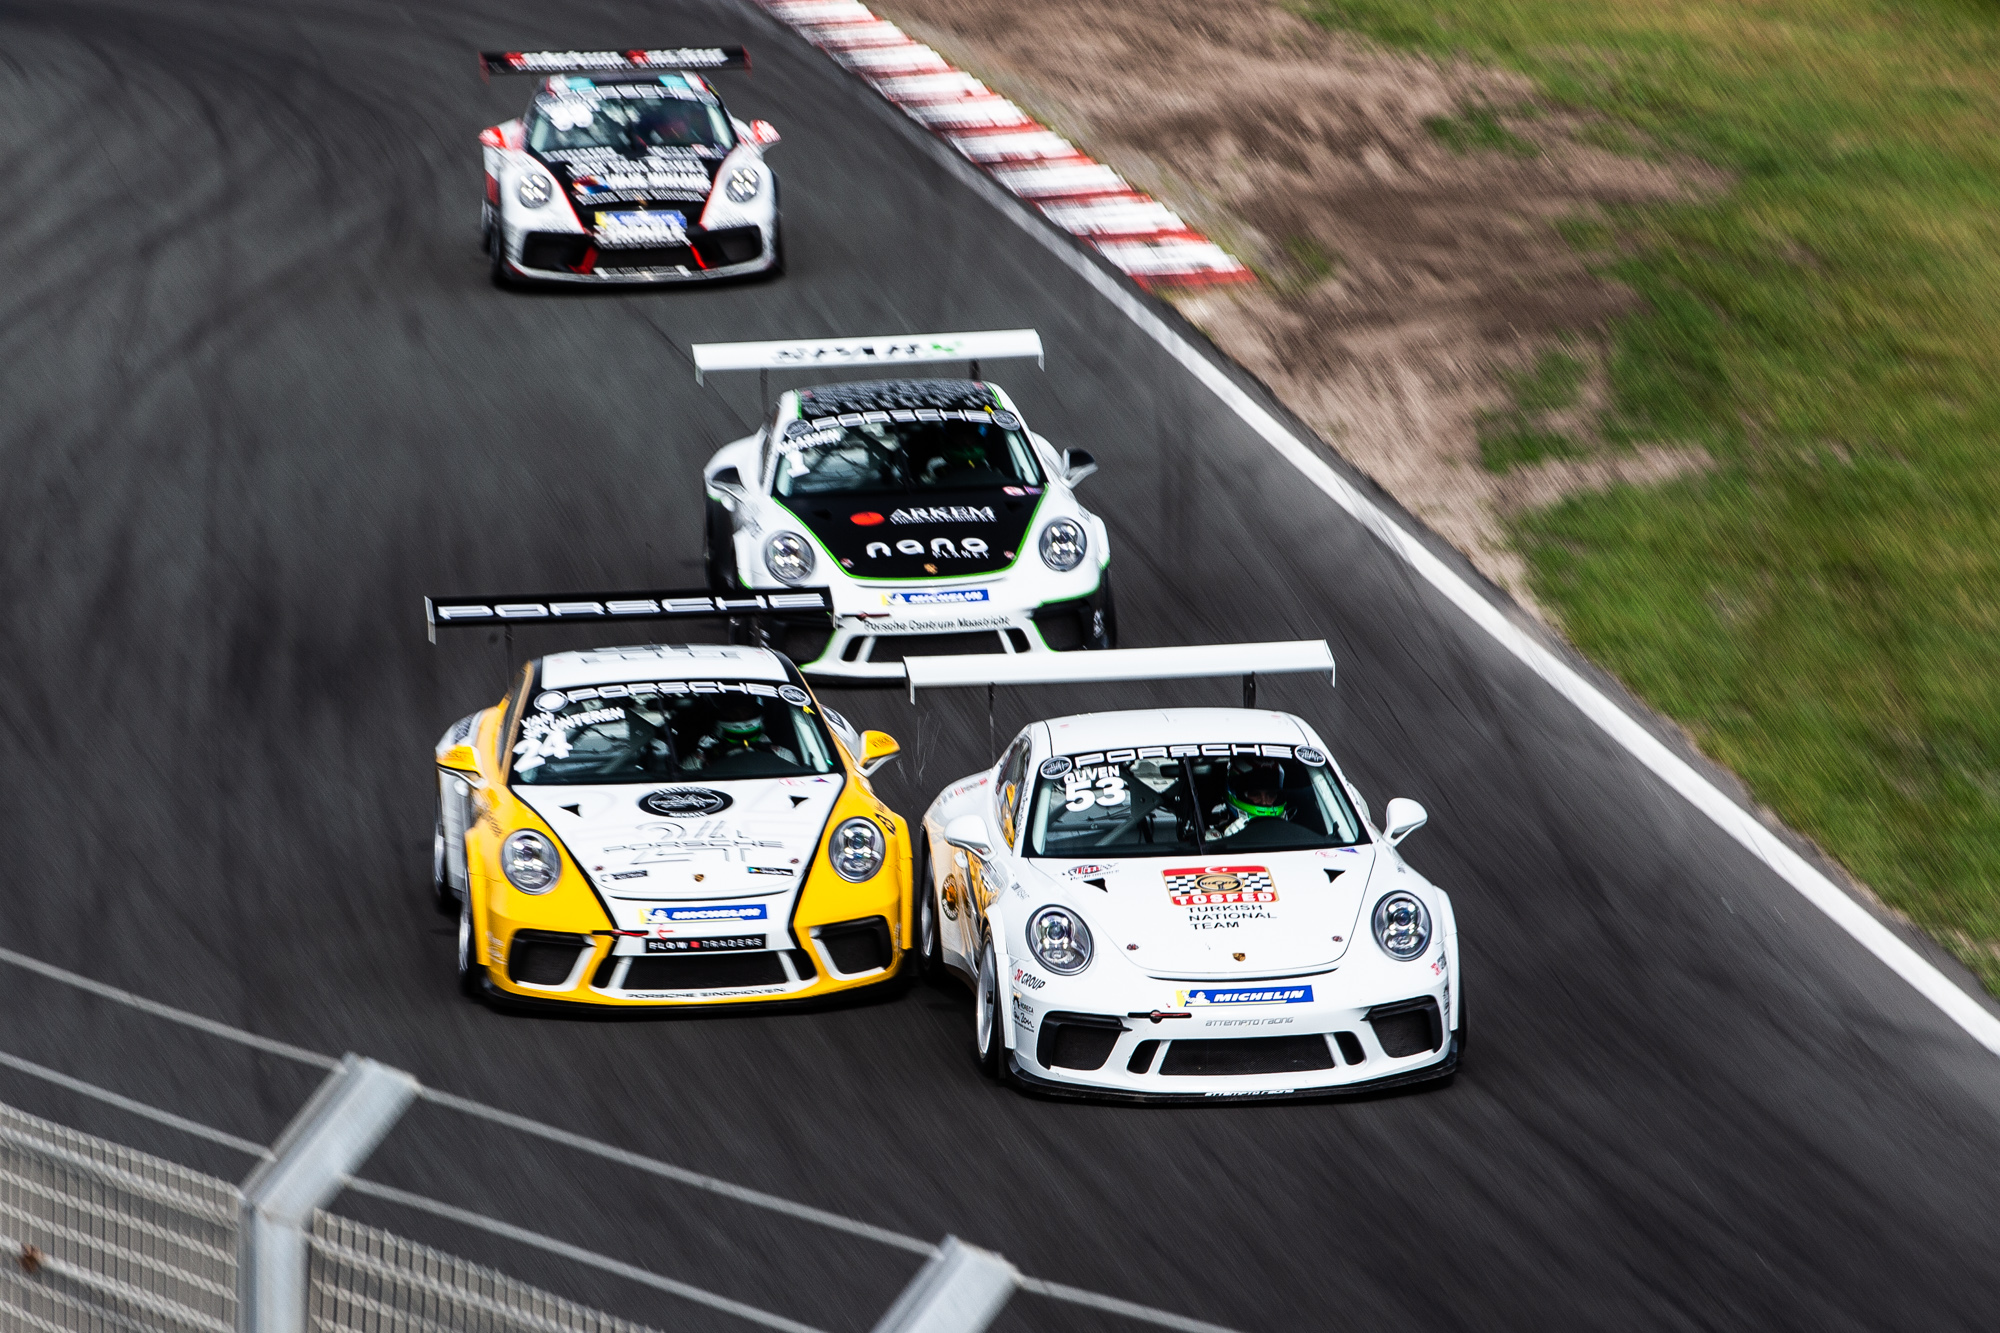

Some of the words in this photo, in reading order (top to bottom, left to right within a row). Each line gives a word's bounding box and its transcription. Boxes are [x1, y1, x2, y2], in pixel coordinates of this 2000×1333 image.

[890, 506, 997, 524] ARKEM
[866, 538, 989, 558] nano
[438, 593, 824, 619] PORSCHE
[567, 681, 779, 703] PORSCHE
[512, 729, 573, 773] 24
[1074, 744, 1292, 768] PORSCHE
[1065, 776, 1126, 812] 53
[1175, 893, 1273, 905] TOSFED
[1187, 904, 1263, 913] TURKISH
[1188, 912, 1277, 921] NATIONAL
[1190, 921, 1240, 930] TEAM
[649, 941, 689, 950] FLOW
[702, 938, 762, 948] TRADERS
[1021, 973, 1046, 990] GROUP
[1214, 989, 1305, 1002] MICHELIN
[1261, 1017, 1294, 1025] racing
